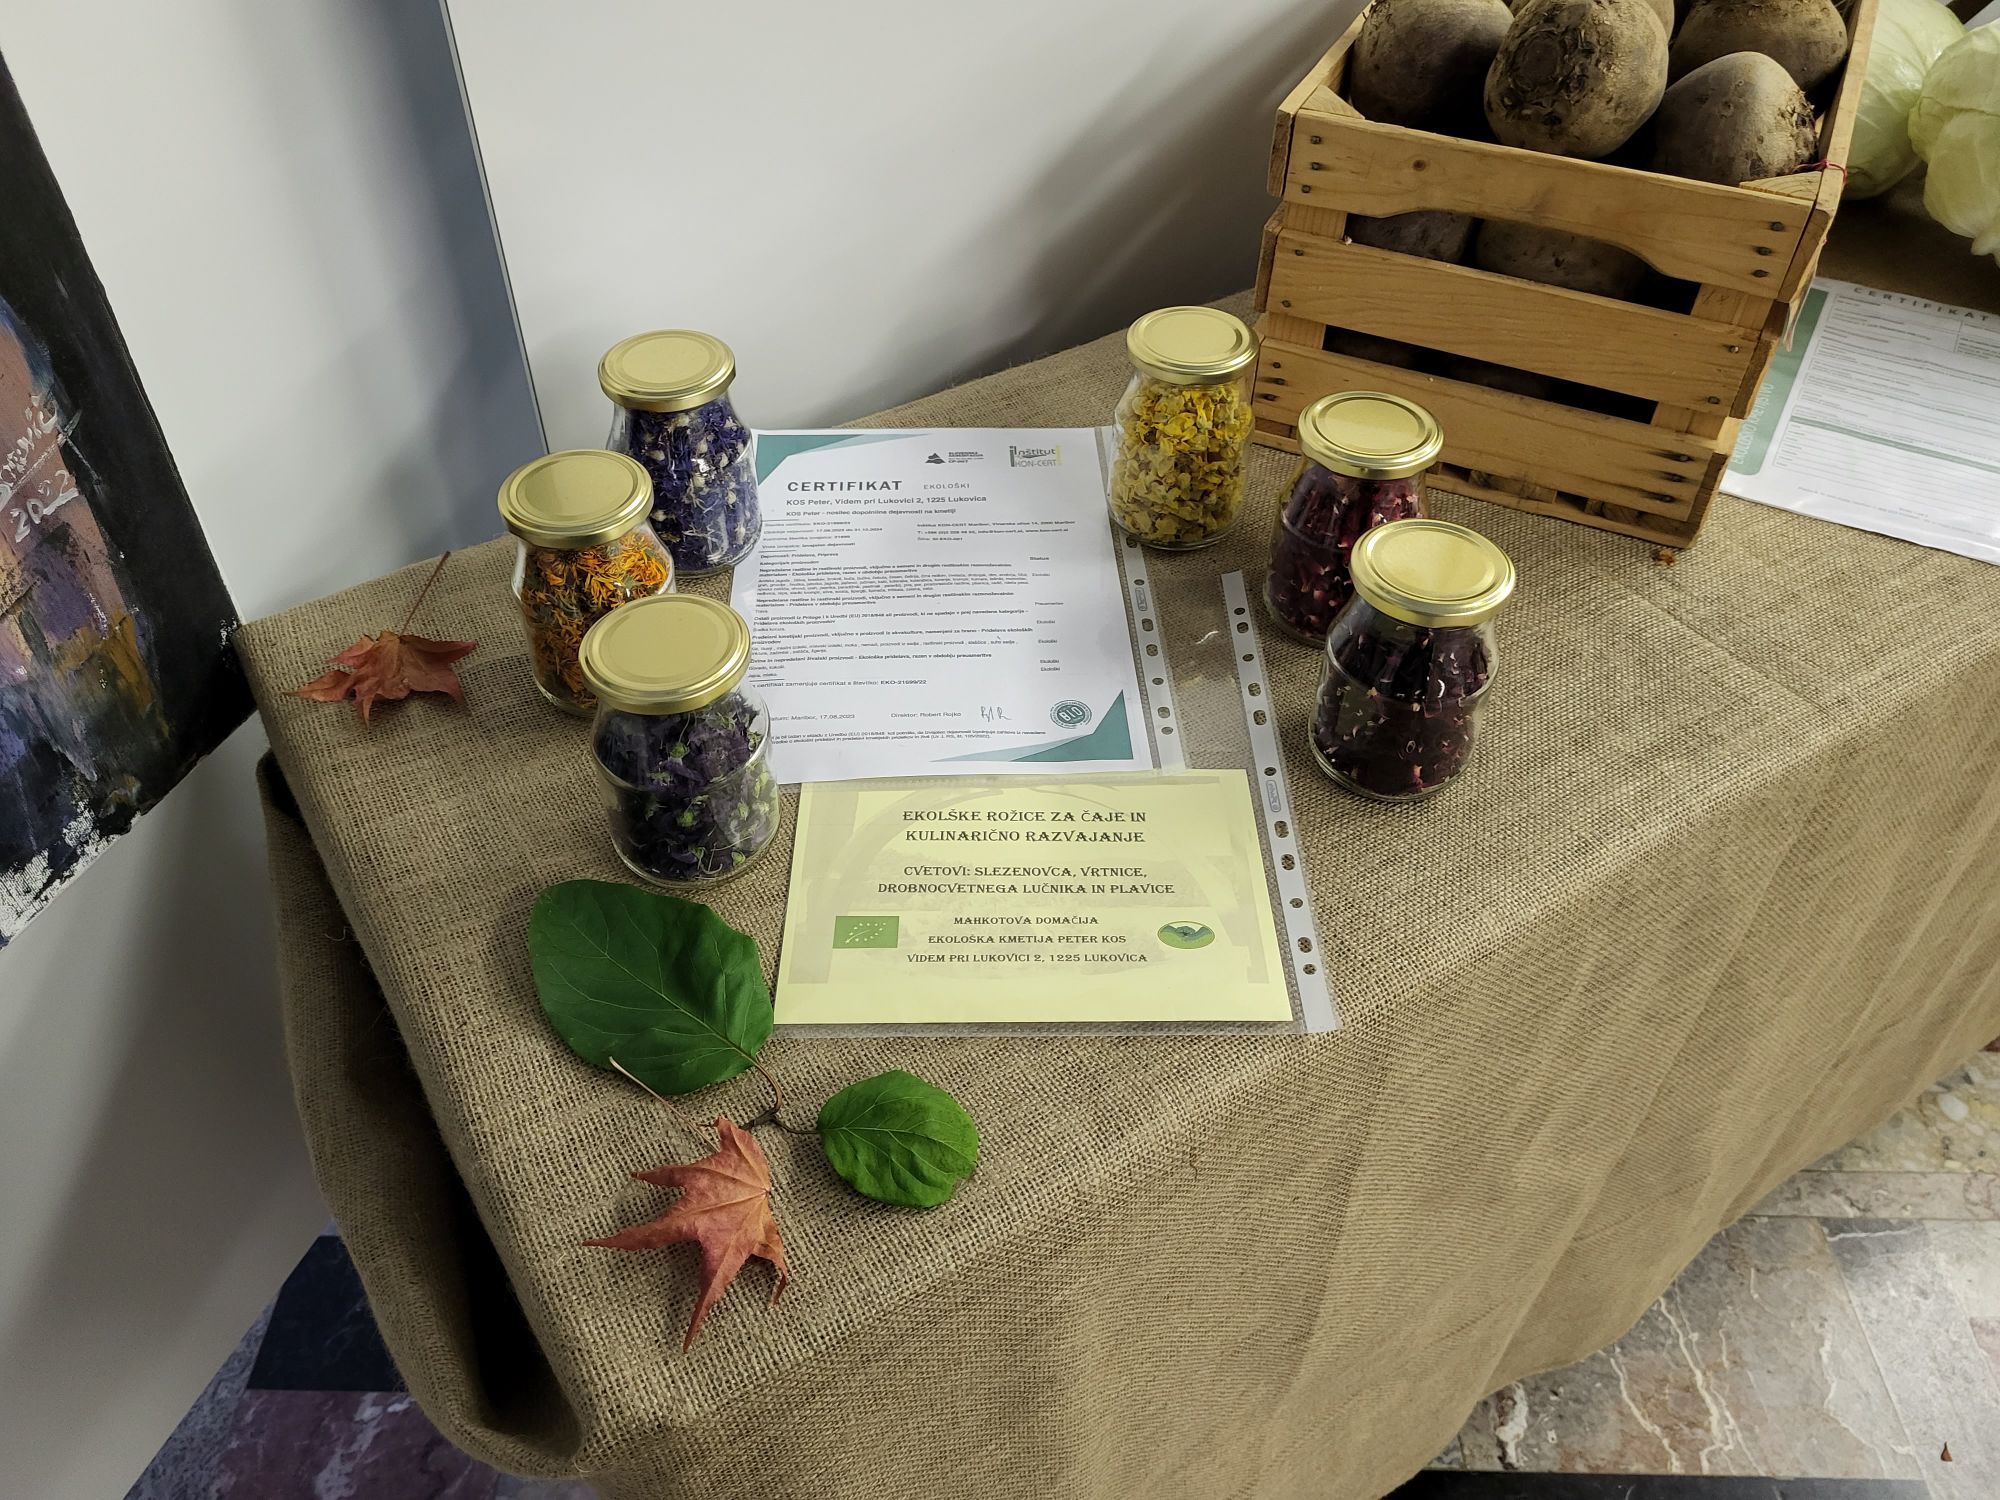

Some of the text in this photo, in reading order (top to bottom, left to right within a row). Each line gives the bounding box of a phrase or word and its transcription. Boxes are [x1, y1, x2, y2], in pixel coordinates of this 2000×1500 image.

[1854, 287, 1988, 321] CERTIFIKAT
[787, 481, 970, 492] CERTIFIKAT EKOLOŠKI
[1058, 706, 1083, 721] BIO
[902, 808, 1146, 823] EKOLŠKE ROŽICE ZA ČAJE IN
[905, 828, 1146, 844] KULINARIČNO RAZVAJANJE
[903, 866, 1147, 879] CVETOVI: SLEZENOVCA, VRTNICE,
[878, 882, 1174, 895] DROBNOCVETNEGA LUČNIKA IN PLAVICE
[953, 915, 1099, 926] MAHKOTOVA DOMAČIJA
[928, 933, 1126, 944] EKOLOŠKA KMETIJA PETER KOS
[907, 954, 1148, 964] VIDEM PRI LUKOVICI 2, 1225 LUKOVICA
